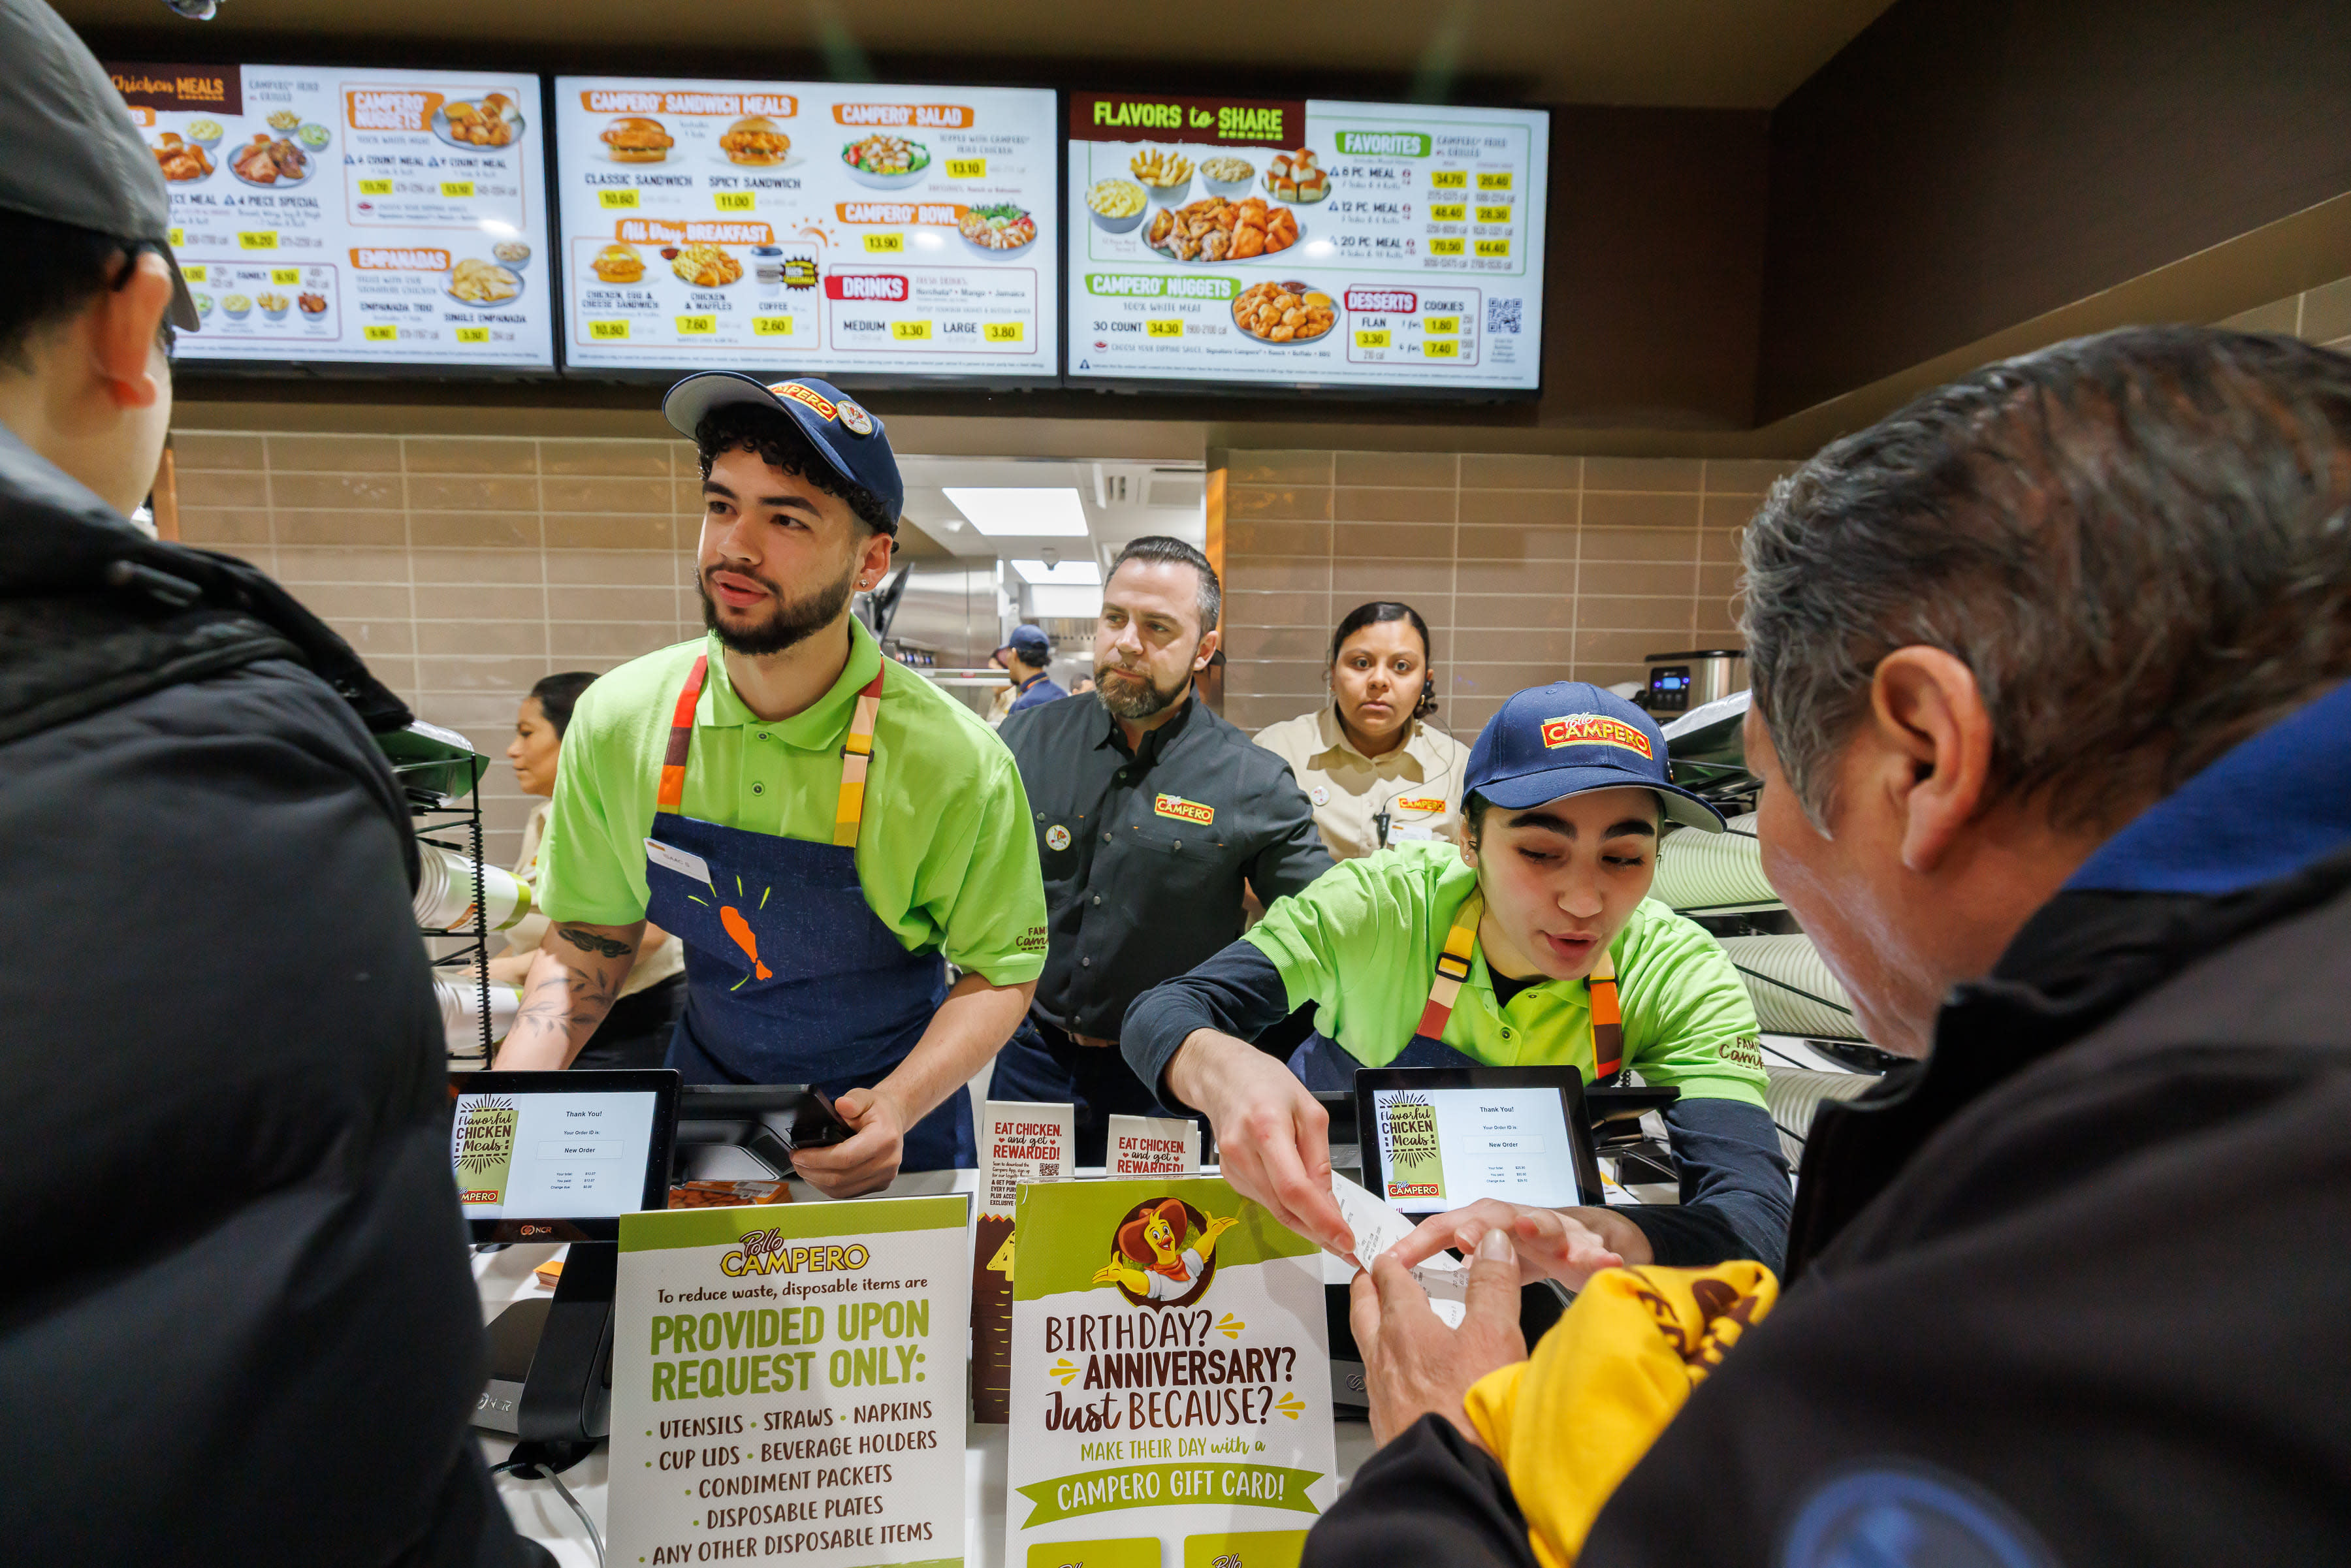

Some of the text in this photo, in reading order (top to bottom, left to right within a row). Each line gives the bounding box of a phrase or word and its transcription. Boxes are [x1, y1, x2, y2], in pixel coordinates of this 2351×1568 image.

[176, 77, 224, 94] MEALS
[665, 93, 741, 114] SANDWICH
[743, 94, 792, 115] MEALS
[916, 107, 963, 125] SALAD
[1094, 101, 1283, 132] FLAVORS to SHARE
[1345, 134, 1421, 155] FAVORITES
[953, 163, 980, 174] 13.10
[1369, 168, 1396, 178] MEAL
[585, 172, 692, 187] CLASSIC SANDWICH
[709, 176, 801, 189] SPICY SANDWICH
[918, 206, 958, 224] BOWL
[1373, 204, 1399, 214] MEAL
[686, 225, 769, 242] BREAKFAST
[869, 237, 898, 249] 13.90
[1375, 238, 1402, 248] MEAL
[357, 249, 447, 270] EMPANADAS
[842, 276, 904, 298] DRINKS
[1167, 277, 1231, 298] NUGGETS
[1349, 293, 1415, 312] DESSERTS
[843, 320, 886, 332] MEDIUM
[899, 324, 923, 336] 3.30
[943, 322, 978, 334] LARGE
[1093, 321, 1179, 334] 30 COUNT 34.30
[1362, 317, 1386, 327] FLAN
[1362, 333, 1384, 344] 3.30
[1561, 712, 1594, 729] Pollo
[1548, 723, 1648, 752] CAMPERO
[1157, 800, 1211, 821] CAMPERO
[1400, 799, 1446, 811] CAMPERO
[458, 1112, 512, 1125] Flavorful
[1381, 1108, 1431, 1121] Flavorful
[456, 1125, 512, 1140] CHICKEN
[995, 1122, 1062, 1137] EAT CHICKEN.
[1382, 1119, 1434, 1134] CHICKEN
[463, 1139, 503, 1153] Meals
[1008, 1134, 1048, 1148] and get
[1119, 1137, 1186, 1155] EAT CHICKEN.
[1392, 1134, 1430, 1147] Meals
[993, 1144, 1061, 1160] REWARDED!
[1131, 1151, 1172, 1164] and get
[1117, 1159, 1185, 1174] REWARDED!
[1389, 1185, 1439, 1196] CAMPERO
[739, 1227, 784, 1256] Pollo
[719, 1243, 871, 1277] CAMPERO
[658, 1275, 929, 1304] To reduce waste, disposable items are
[650, 1298, 930, 1356] PROVIDED UPON
[1046, 1309, 1213, 1354] BIRTHDAY?
[652, 1344, 927, 1402] REQUEST ONLY:
[1083, 1345, 1297, 1391] ANNIVERSARY?
[1045, 1385, 1275, 1433] Just BECAUSE?
[660, 1400, 933, 1440] UTENSILS STRAWS NAPKINS
[659, 1429, 938, 1471] CUP LIDS BEVERAGE HOLDERS
[1081, 1436, 1266, 1462] MAKE THEIR DAY with a
[698, 1464, 893, 1499] CONDIMENT PACKETS
[1057, 1469, 1285, 1511] CAMPERO GIFT CARD!
[707, 1495, 884, 1530] DISPOSABLE PLATES
[652, 1521, 933, 1566] ANY OTHER DISPOSABLE ITEMS
